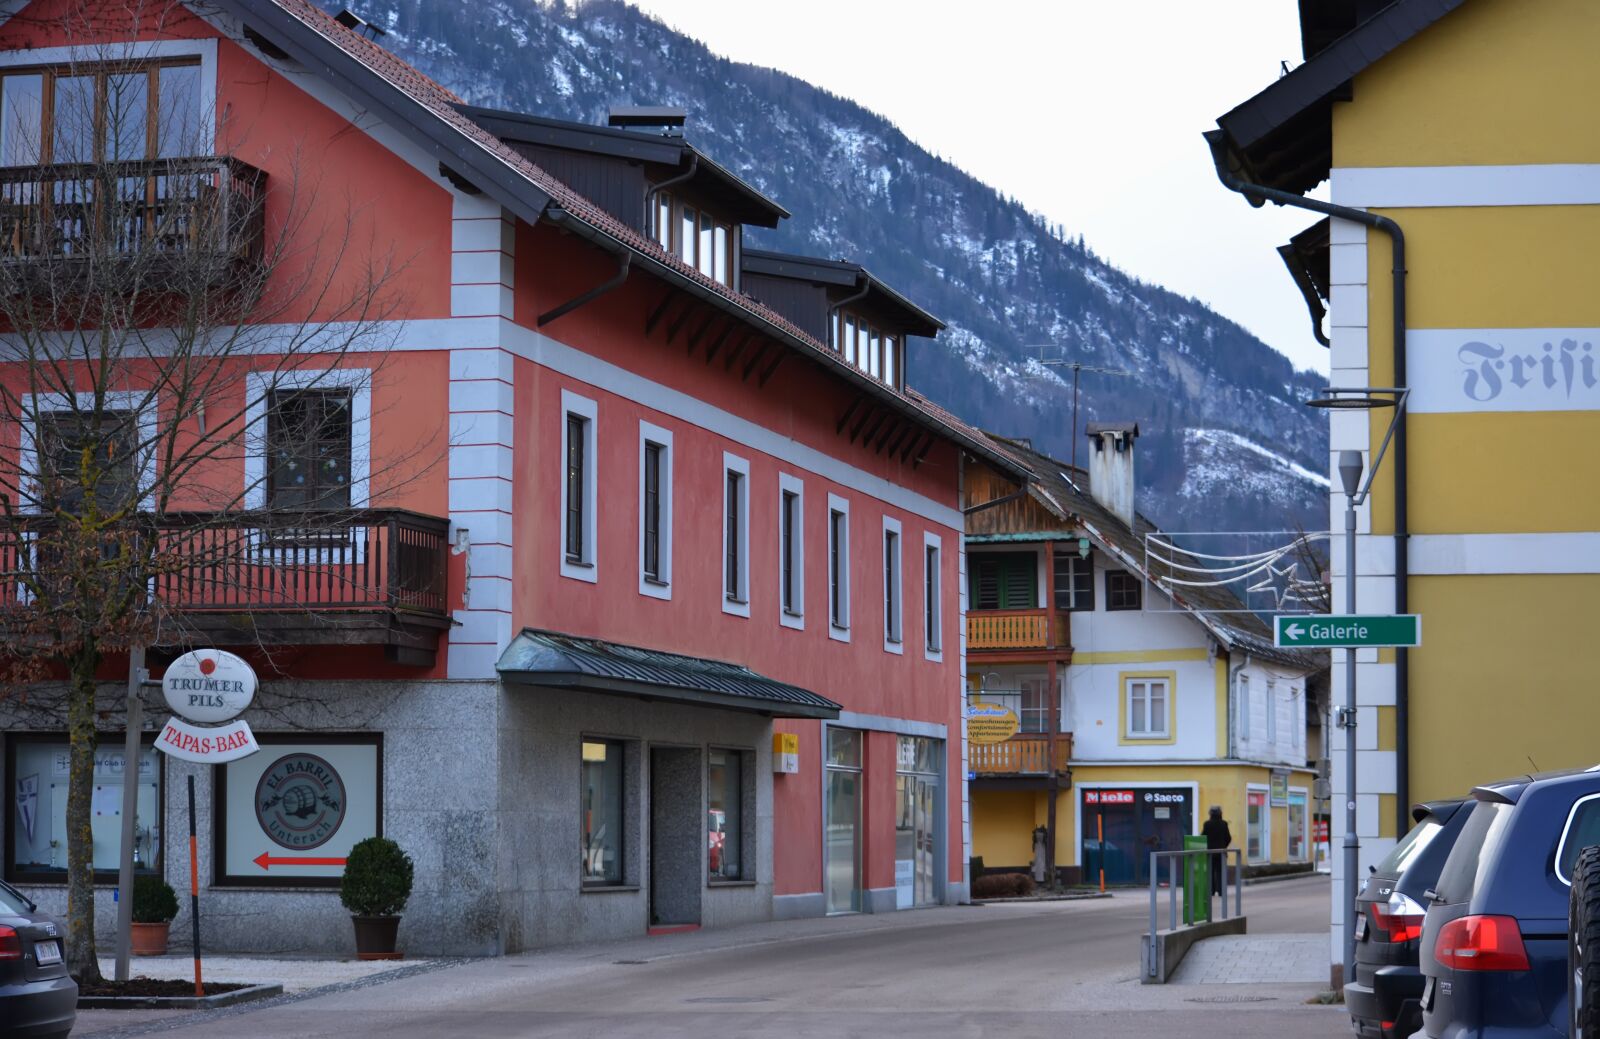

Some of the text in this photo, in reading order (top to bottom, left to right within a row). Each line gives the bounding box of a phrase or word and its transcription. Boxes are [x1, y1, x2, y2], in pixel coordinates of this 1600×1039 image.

[1309, 623, 1368, 639] Galerie
[169, 678, 245, 693] TRUMER
[188, 694, 224, 707] PILS
[163, 725, 249, 754] TAPAS-BAR
[266, 761, 333, 790] EL BARRIL
[1087, 792, 1184, 802] Miele Saeco
[269, 820, 332, 844] Unterach
